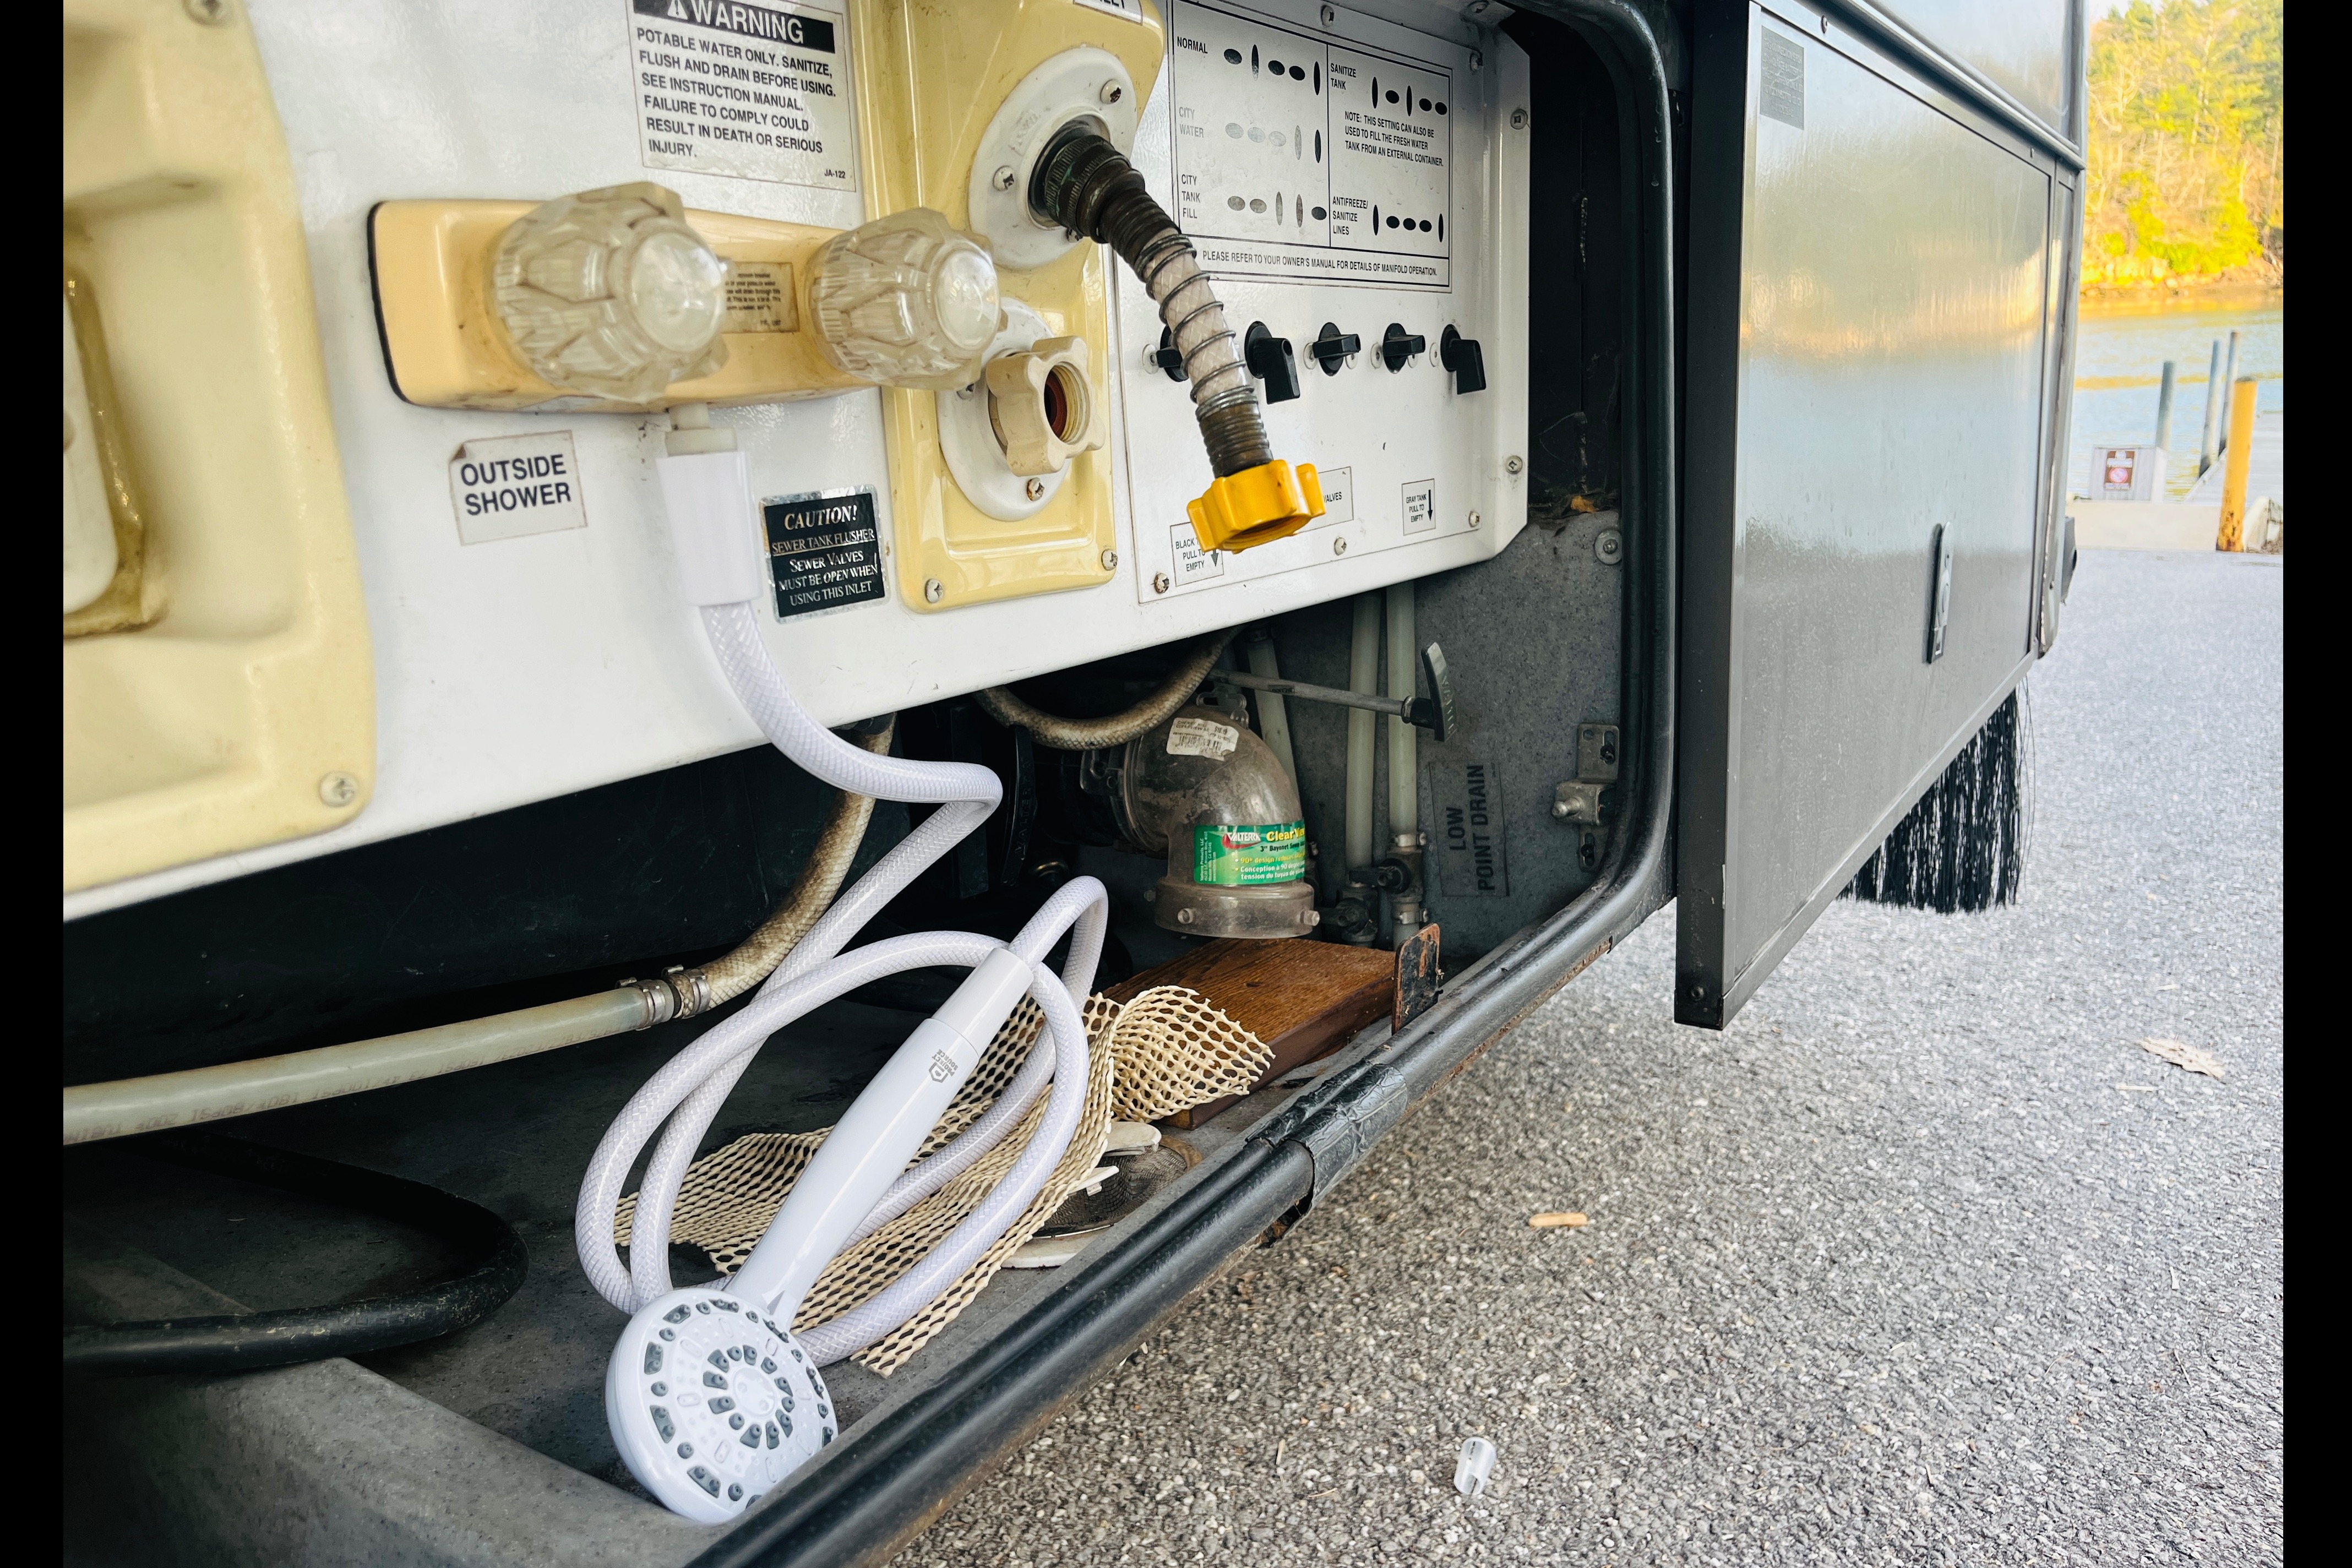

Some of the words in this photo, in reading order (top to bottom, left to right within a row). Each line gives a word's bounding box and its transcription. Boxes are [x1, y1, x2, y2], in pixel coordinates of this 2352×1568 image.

[690, 0, 804, 44] WARNING
[637, 28, 695, 51] POTABLE
[699, 39, 742, 60] WATER
[745, 48, 780, 67] ONLY.
[782, 56, 832, 79] SANITIZE,
[1177, 36, 1208, 54] NORMAL
[640, 50, 680, 69] FLUSH
[685, 59, 710, 74] AND
[714, 64, 749, 82] DRAIN
[753, 72, 798, 90] BEFORE
[801, 82, 836, 97] USING.
[1331, 63, 1357, 78] SANITIZE
[642, 73, 666, 89] SEE
[670, 77, 750, 102] INSTRUCTION
[754, 91, 803, 111] MANUAL.
[1331, 78, 1346, 90] TANK
[644, 95, 697, 115] FAILURE
[700, 104, 717, 118] TO
[720, 107, 768, 127] COMPLY
[771, 118, 809, 132] COULD
[1179, 106, 1195, 119] CITY
[1180, 124, 1204, 138] WATER
[1345, 111, 1362, 123] NOTE:
[1364, 115, 1376, 126] THIS
[1378, 118, 1400, 131] SETTING
[1401, 123, 1412, 133] CAN
[1413, 126, 1426, 137] ALSO
[1427, 129, 1434, 138] BE
[646, 117, 695, 136] RESULT
[699, 126, 711, 138] IN
[714, 127, 753, 144] DEATH
[755, 134, 772, 146] OR
[775, 136, 823, 154] SERIOUS
[1345, 126, 1360, 137] USED
[1362, 129, 1368, 139] TO
[1370, 130, 1381, 141] FILL
[1382, 133, 1392, 144] THE
[1393, 136, 1411, 147] FRESH
[1411, 139, 1428, 150] WATER
[649, 139, 698, 158] INJURY.
[1345, 140, 1360, 151] TANK
[1362, 143, 1376, 155] FROM
[1378, 146, 1385, 156] AN
[1387, 148, 1413, 161] EXTERNAL
[824, 169, 846, 179] JA-122
[1182, 173, 1197, 186] CITY
[1182, 190, 1201, 203] TANK
[1332, 196, 1368, 209] ANTIFREEZE/
[1183, 208, 1197, 219] FILL
[1333, 211, 1358, 222] SANITIZE
[1333, 226, 1349, 236] LINES
[1202, 251, 1229, 262] PLEASE
[1231, 252, 1253, 263] REFER
[1254, 254, 1262, 264] TO
[1264, 255, 1281, 265] YOUR
[1282, 256, 1310, 267] OWNER'S
[1311, 258, 1336, 269] MANUAL
[1337, 260, 1348, 270] FOR
[1349, 261, 1372, 271] DETAILS
[1373, 263, 1380, 271] OF
[1381, 264, 1408, 274] MANIFOLD
[1409, 266, 1437, 276] OPERATION.
[460, 454, 567, 486] OUTSIDE
[465, 482, 571, 516] SHOWER
[1406, 495, 1417, 503] GRAY
[1409, 505, 1418, 513] PULL
[784, 505, 857, 530] CAUTION!
[1411, 514, 1423, 522] EMPTY
[772, 539, 806, 554] SEWER
[807, 534, 834, 548] TANK
[834, 529, 875, 545] FLUSHER
[1175, 537, 1195, 549] BLACK
[790, 556, 826, 573] SEWER
[827, 551, 864, 566] VALVES
[1183, 550, 1197, 560] PULL
[1186, 560, 1204, 571] EMPTY
[778, 576, 807, 591] MUST
[809, 574, 823, 586] BE
[823, 569, 849, 584] OPEN
[850, 564, 878, 577] WHEN
[790, 591, 821, 606] USING
[821, 586, 844, 600] THIS
[845, 581, 872, 595] INLET
[1466, 765, 1488, 826] DRAIN
[1227, 832, 1261, 841] VALTERRA
[1446, 807, 1466, 851] LOW
[1472, 832, 1495, 891] POINT
[932, 1054, 955, 1076] PROJECT
[937, 1049, 958, 1071] SOURCE
